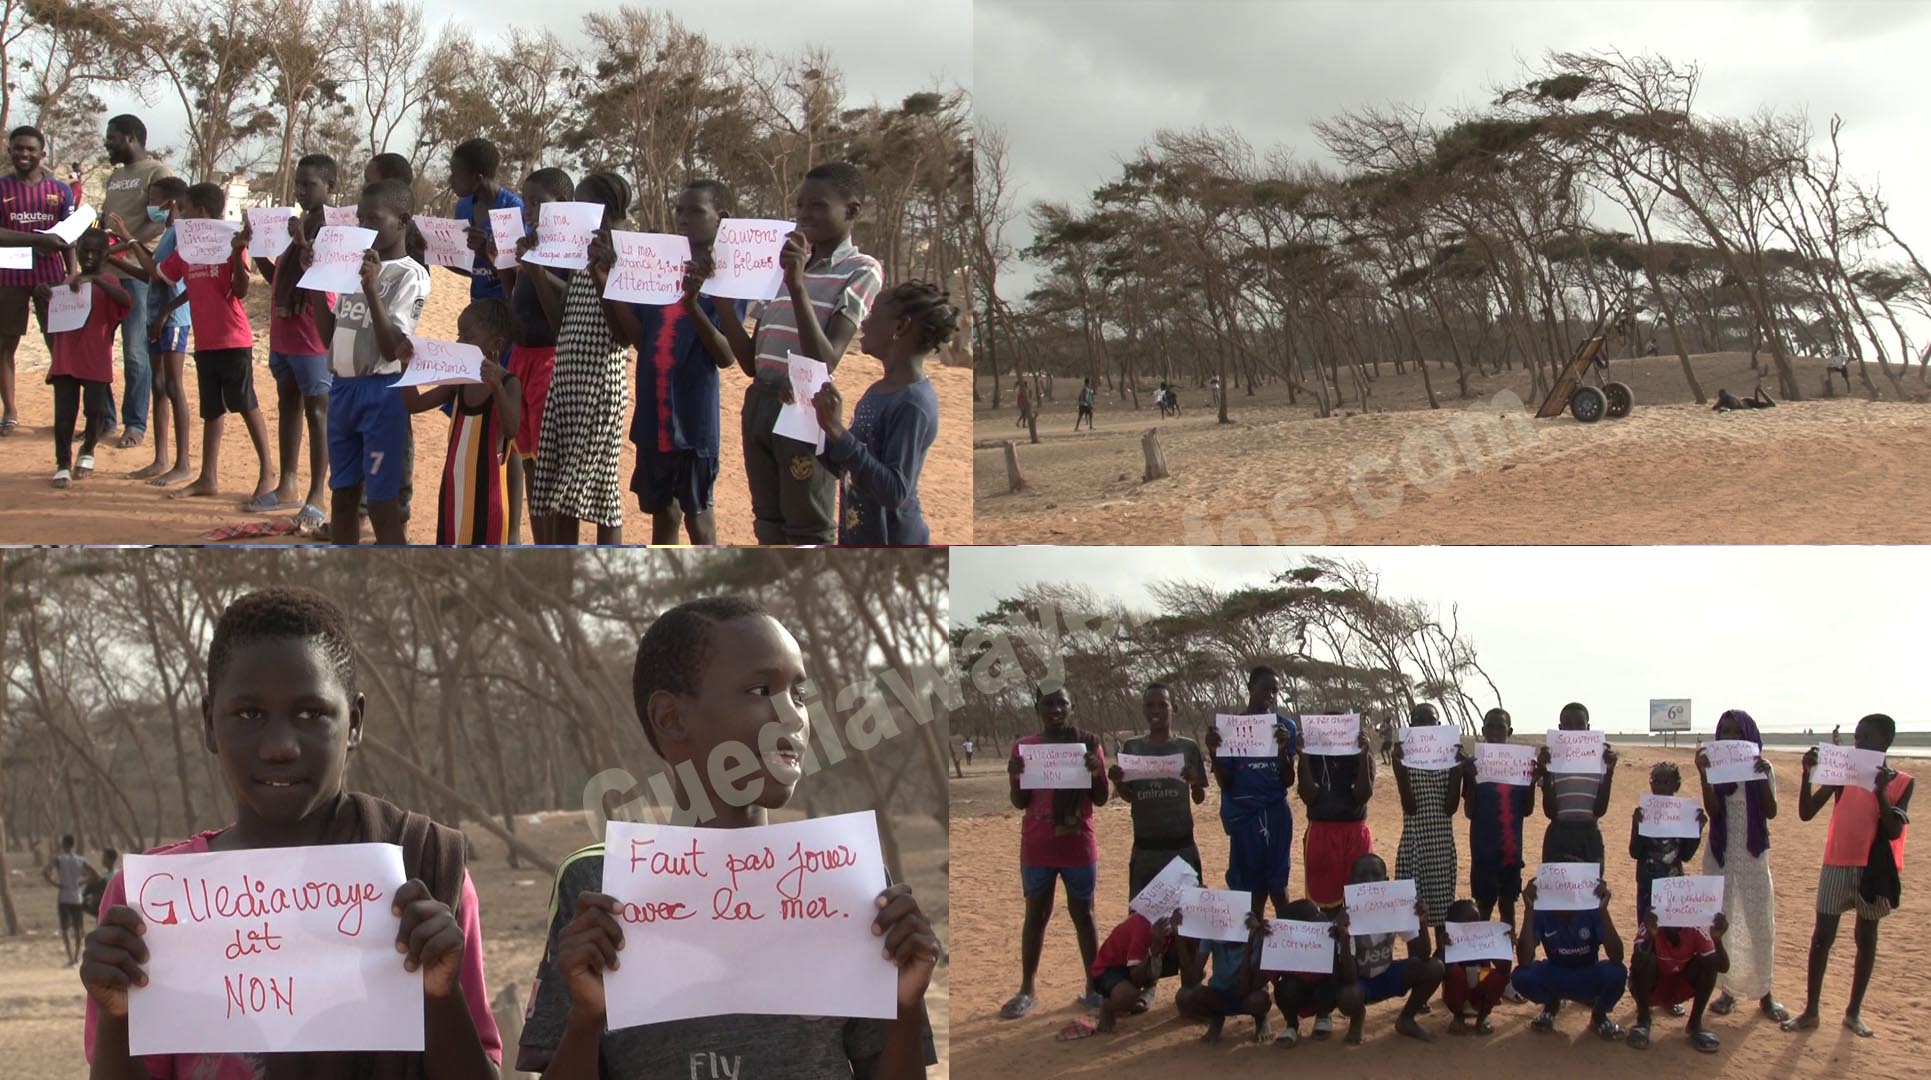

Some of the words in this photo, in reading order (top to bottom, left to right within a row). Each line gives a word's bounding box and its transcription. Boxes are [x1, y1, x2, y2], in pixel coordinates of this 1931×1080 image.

[10, 212, 54, 223] Rakuten
[719, 224, 778, 245] Sauvons
[370, 452, 385, 475] 7
[630, 838, 708, 877] Faut
[726, 847, 775, 892] pas
[622, 901, 697, 924] avec
[712, 887, 765, 921] la
[225, 922, 282, 959] dit
[224, 973, 294, 1019] NON
[690, 1051, 742, 1080] Fly
